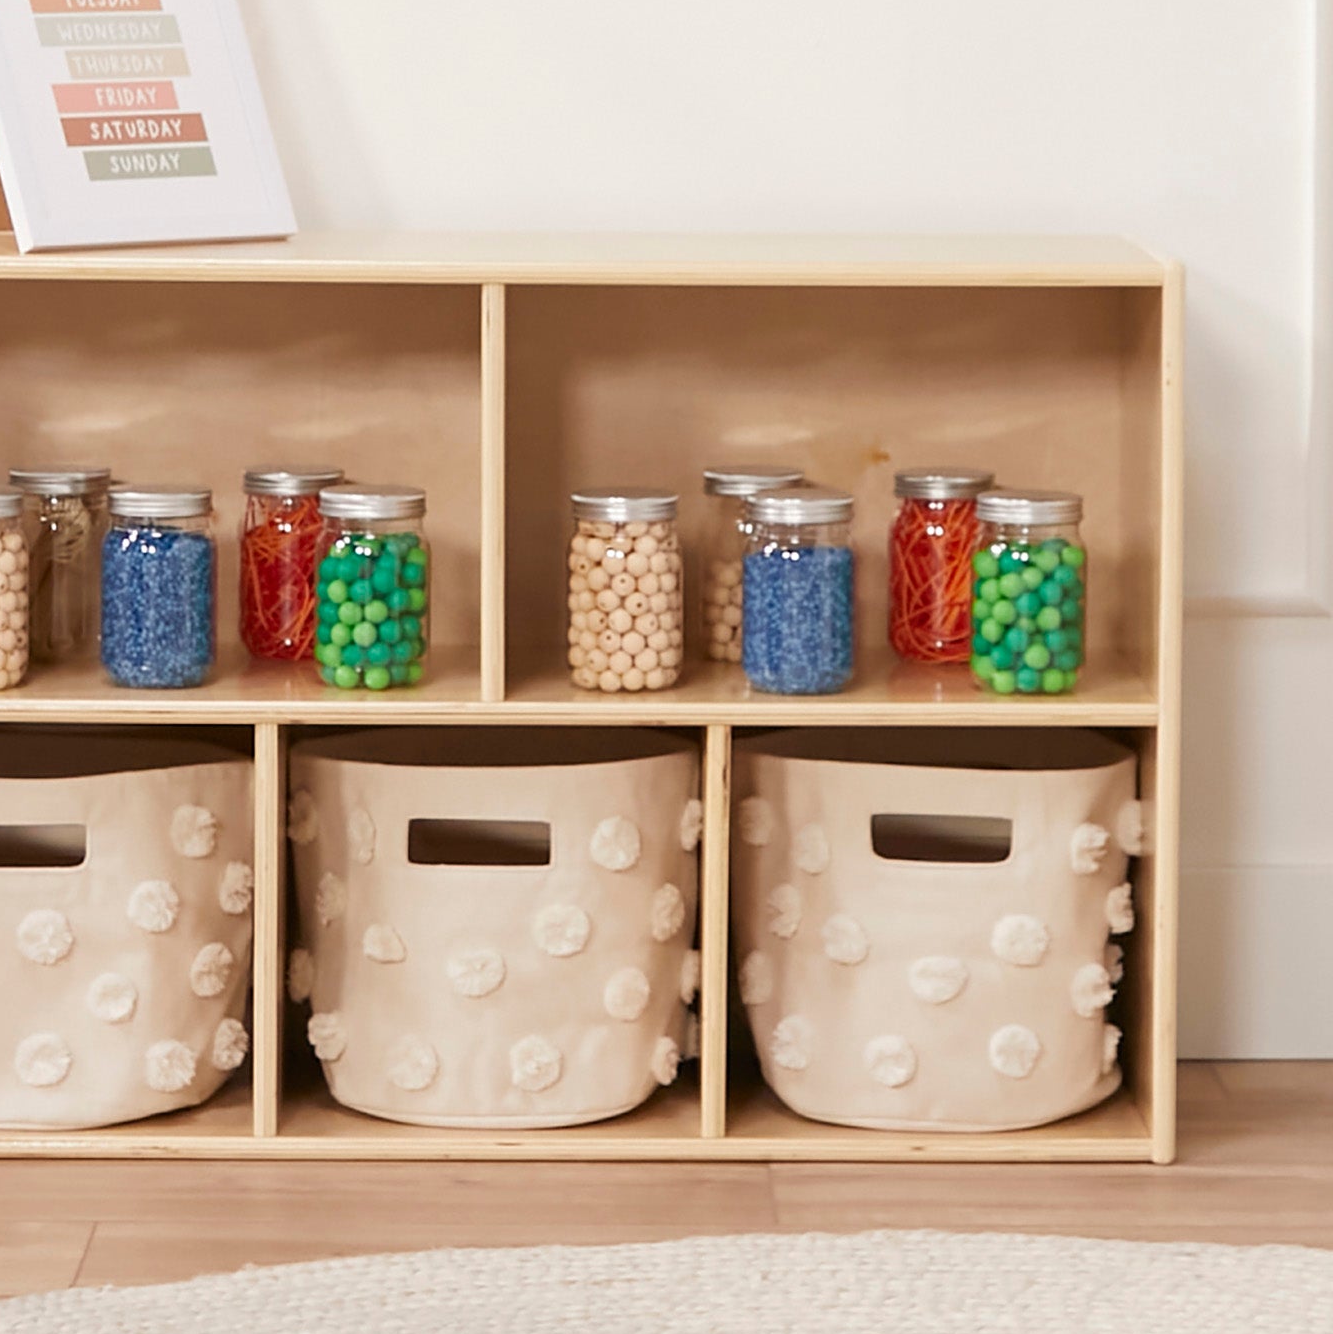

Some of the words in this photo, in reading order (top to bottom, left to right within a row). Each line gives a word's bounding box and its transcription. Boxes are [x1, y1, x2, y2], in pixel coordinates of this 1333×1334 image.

[57, 20, 162, 42] WEDNESDAY
[72, 53, 165, 75] THURSDAY
[95, 86, 157, 107] FRIDAY
[89, 118, 182, 140] SATURDAY
[110, 152, 181, 174] SUNDAY
